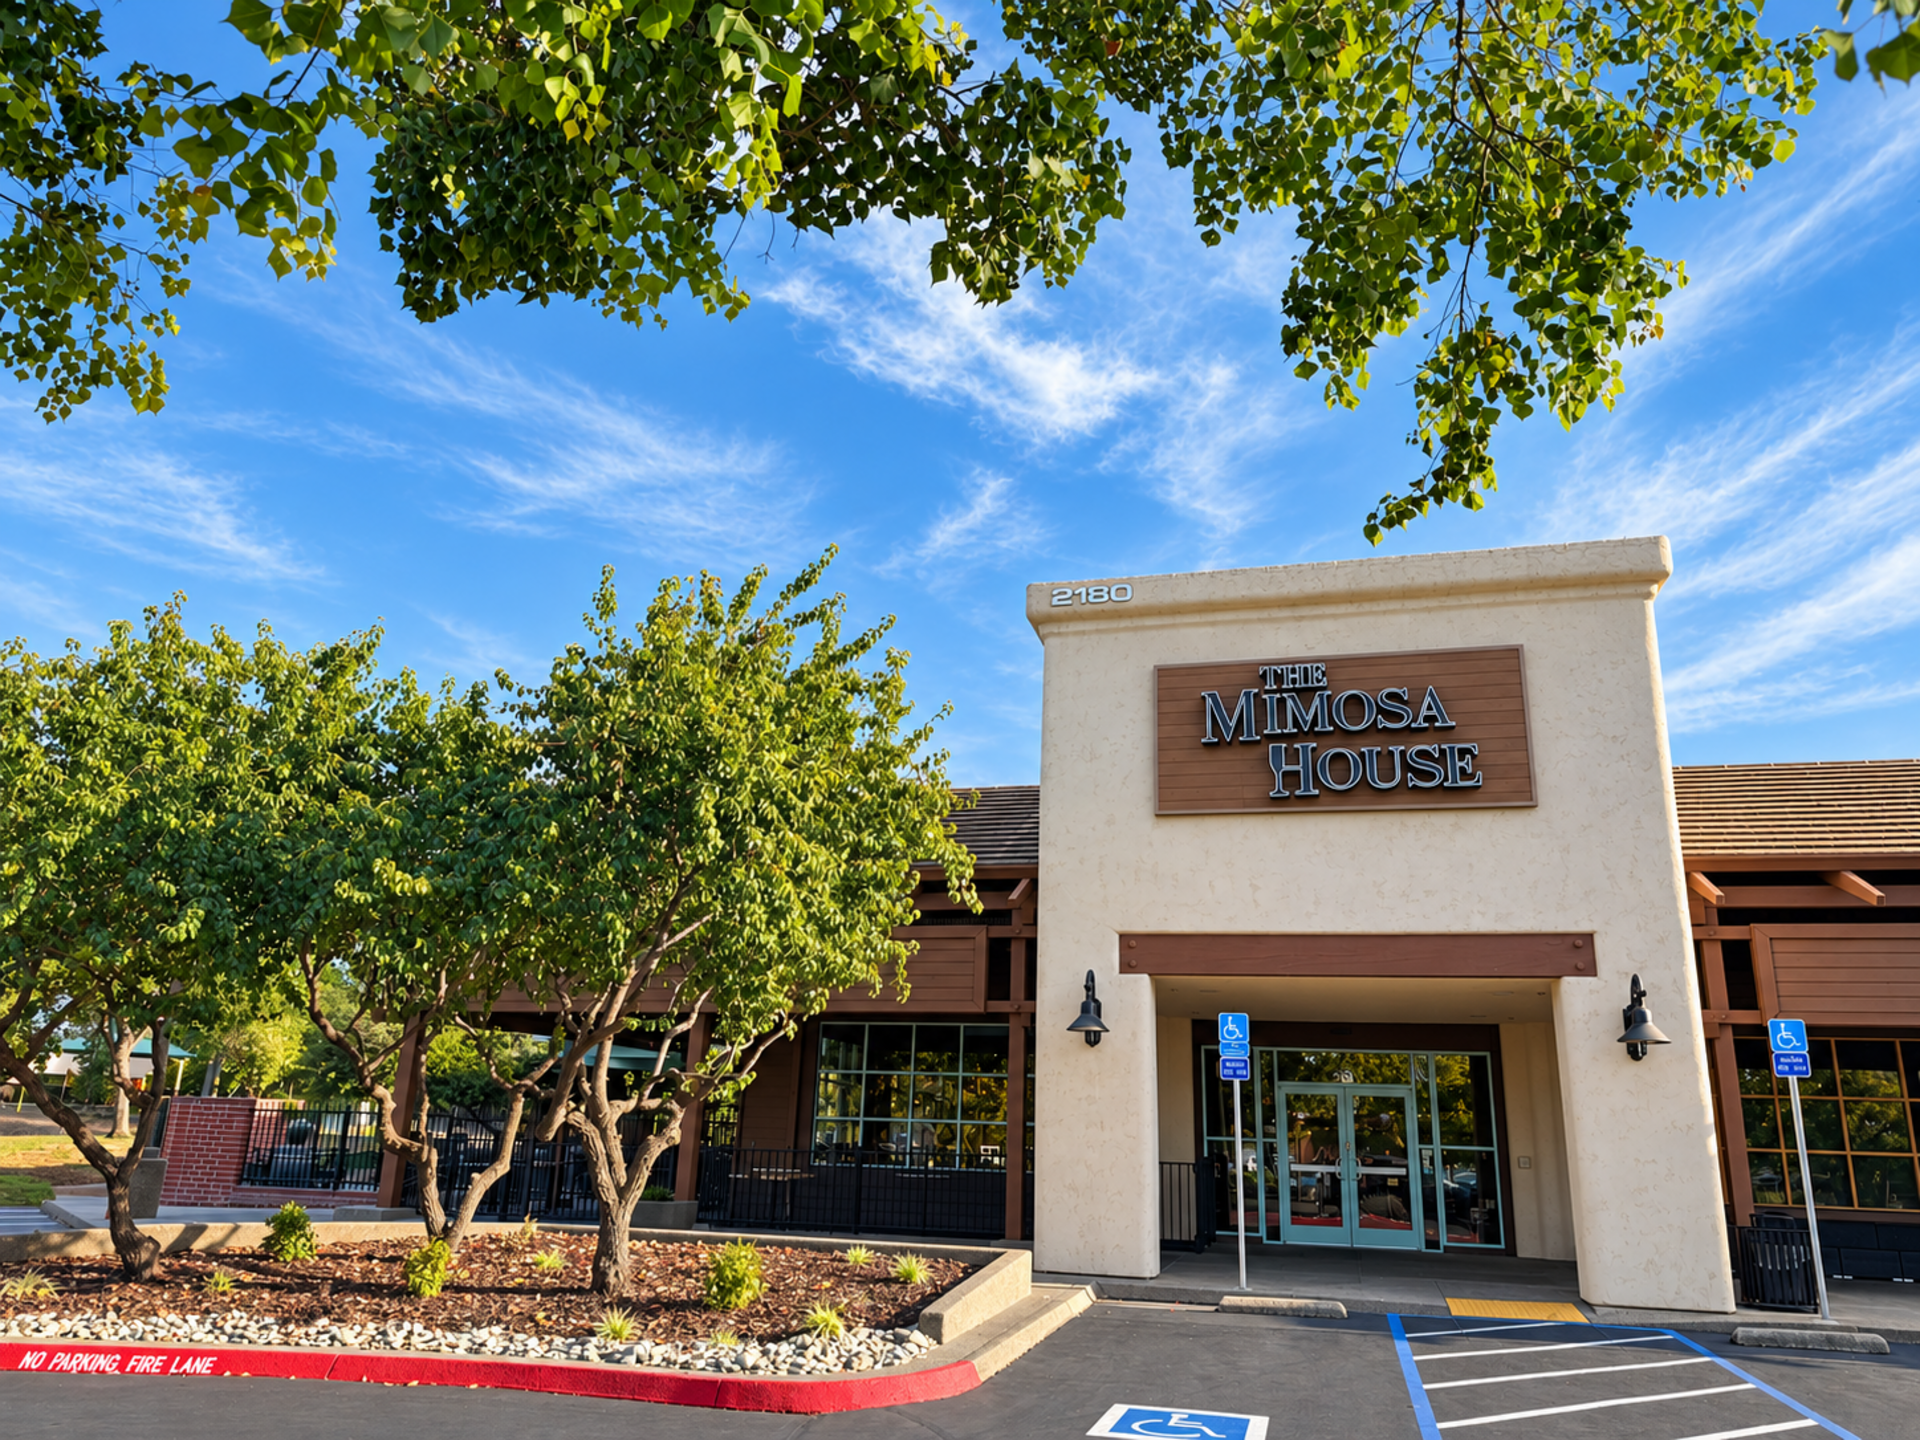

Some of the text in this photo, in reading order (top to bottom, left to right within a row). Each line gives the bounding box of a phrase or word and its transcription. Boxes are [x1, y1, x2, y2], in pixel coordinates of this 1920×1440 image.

[1051, 583, 1133, 606] 2180
[1259, 663, 1328, 690] THE
[1201, 686, 1456, 744] MIMOSA
[1269, 742, 1483, 798] HOUSE
[18, 1351, 218, 1374] NO PARKING FIRE LANE
